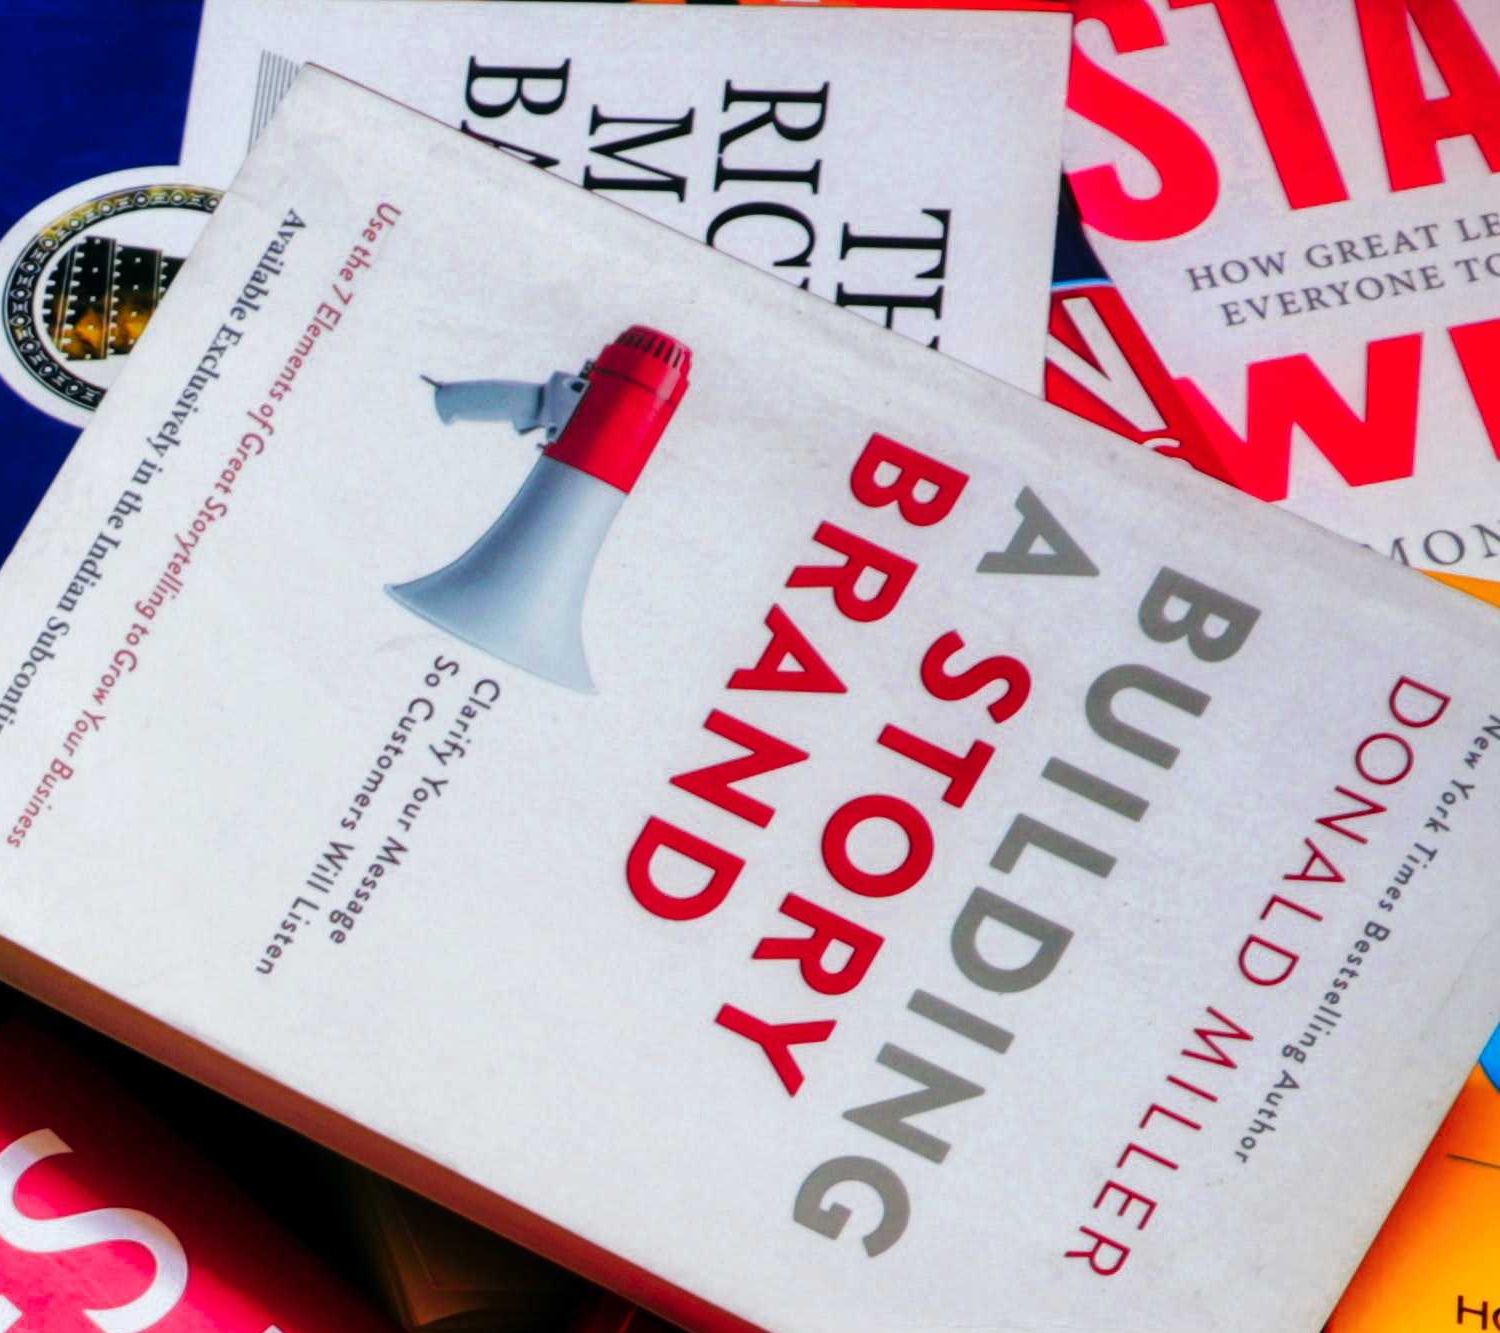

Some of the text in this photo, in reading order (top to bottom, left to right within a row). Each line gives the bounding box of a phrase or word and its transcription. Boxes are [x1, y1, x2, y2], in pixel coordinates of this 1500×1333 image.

[229, 209, 305, 320] Available
[131, 458, 162, 485] in
[151, 324, 242, 457] Exclusively
[56, 532, 120, 612] Indian
[106, 490, 142, 529] the
[626, 431, 971, 923] BRAND
[715, 486, 1100, 1097] A STORY
[1237, 675, 1451, 989] DONALD
[792, 565, 1262, 1258] BUILDING
[1064, 1006, 1254, 1278] MILLER
